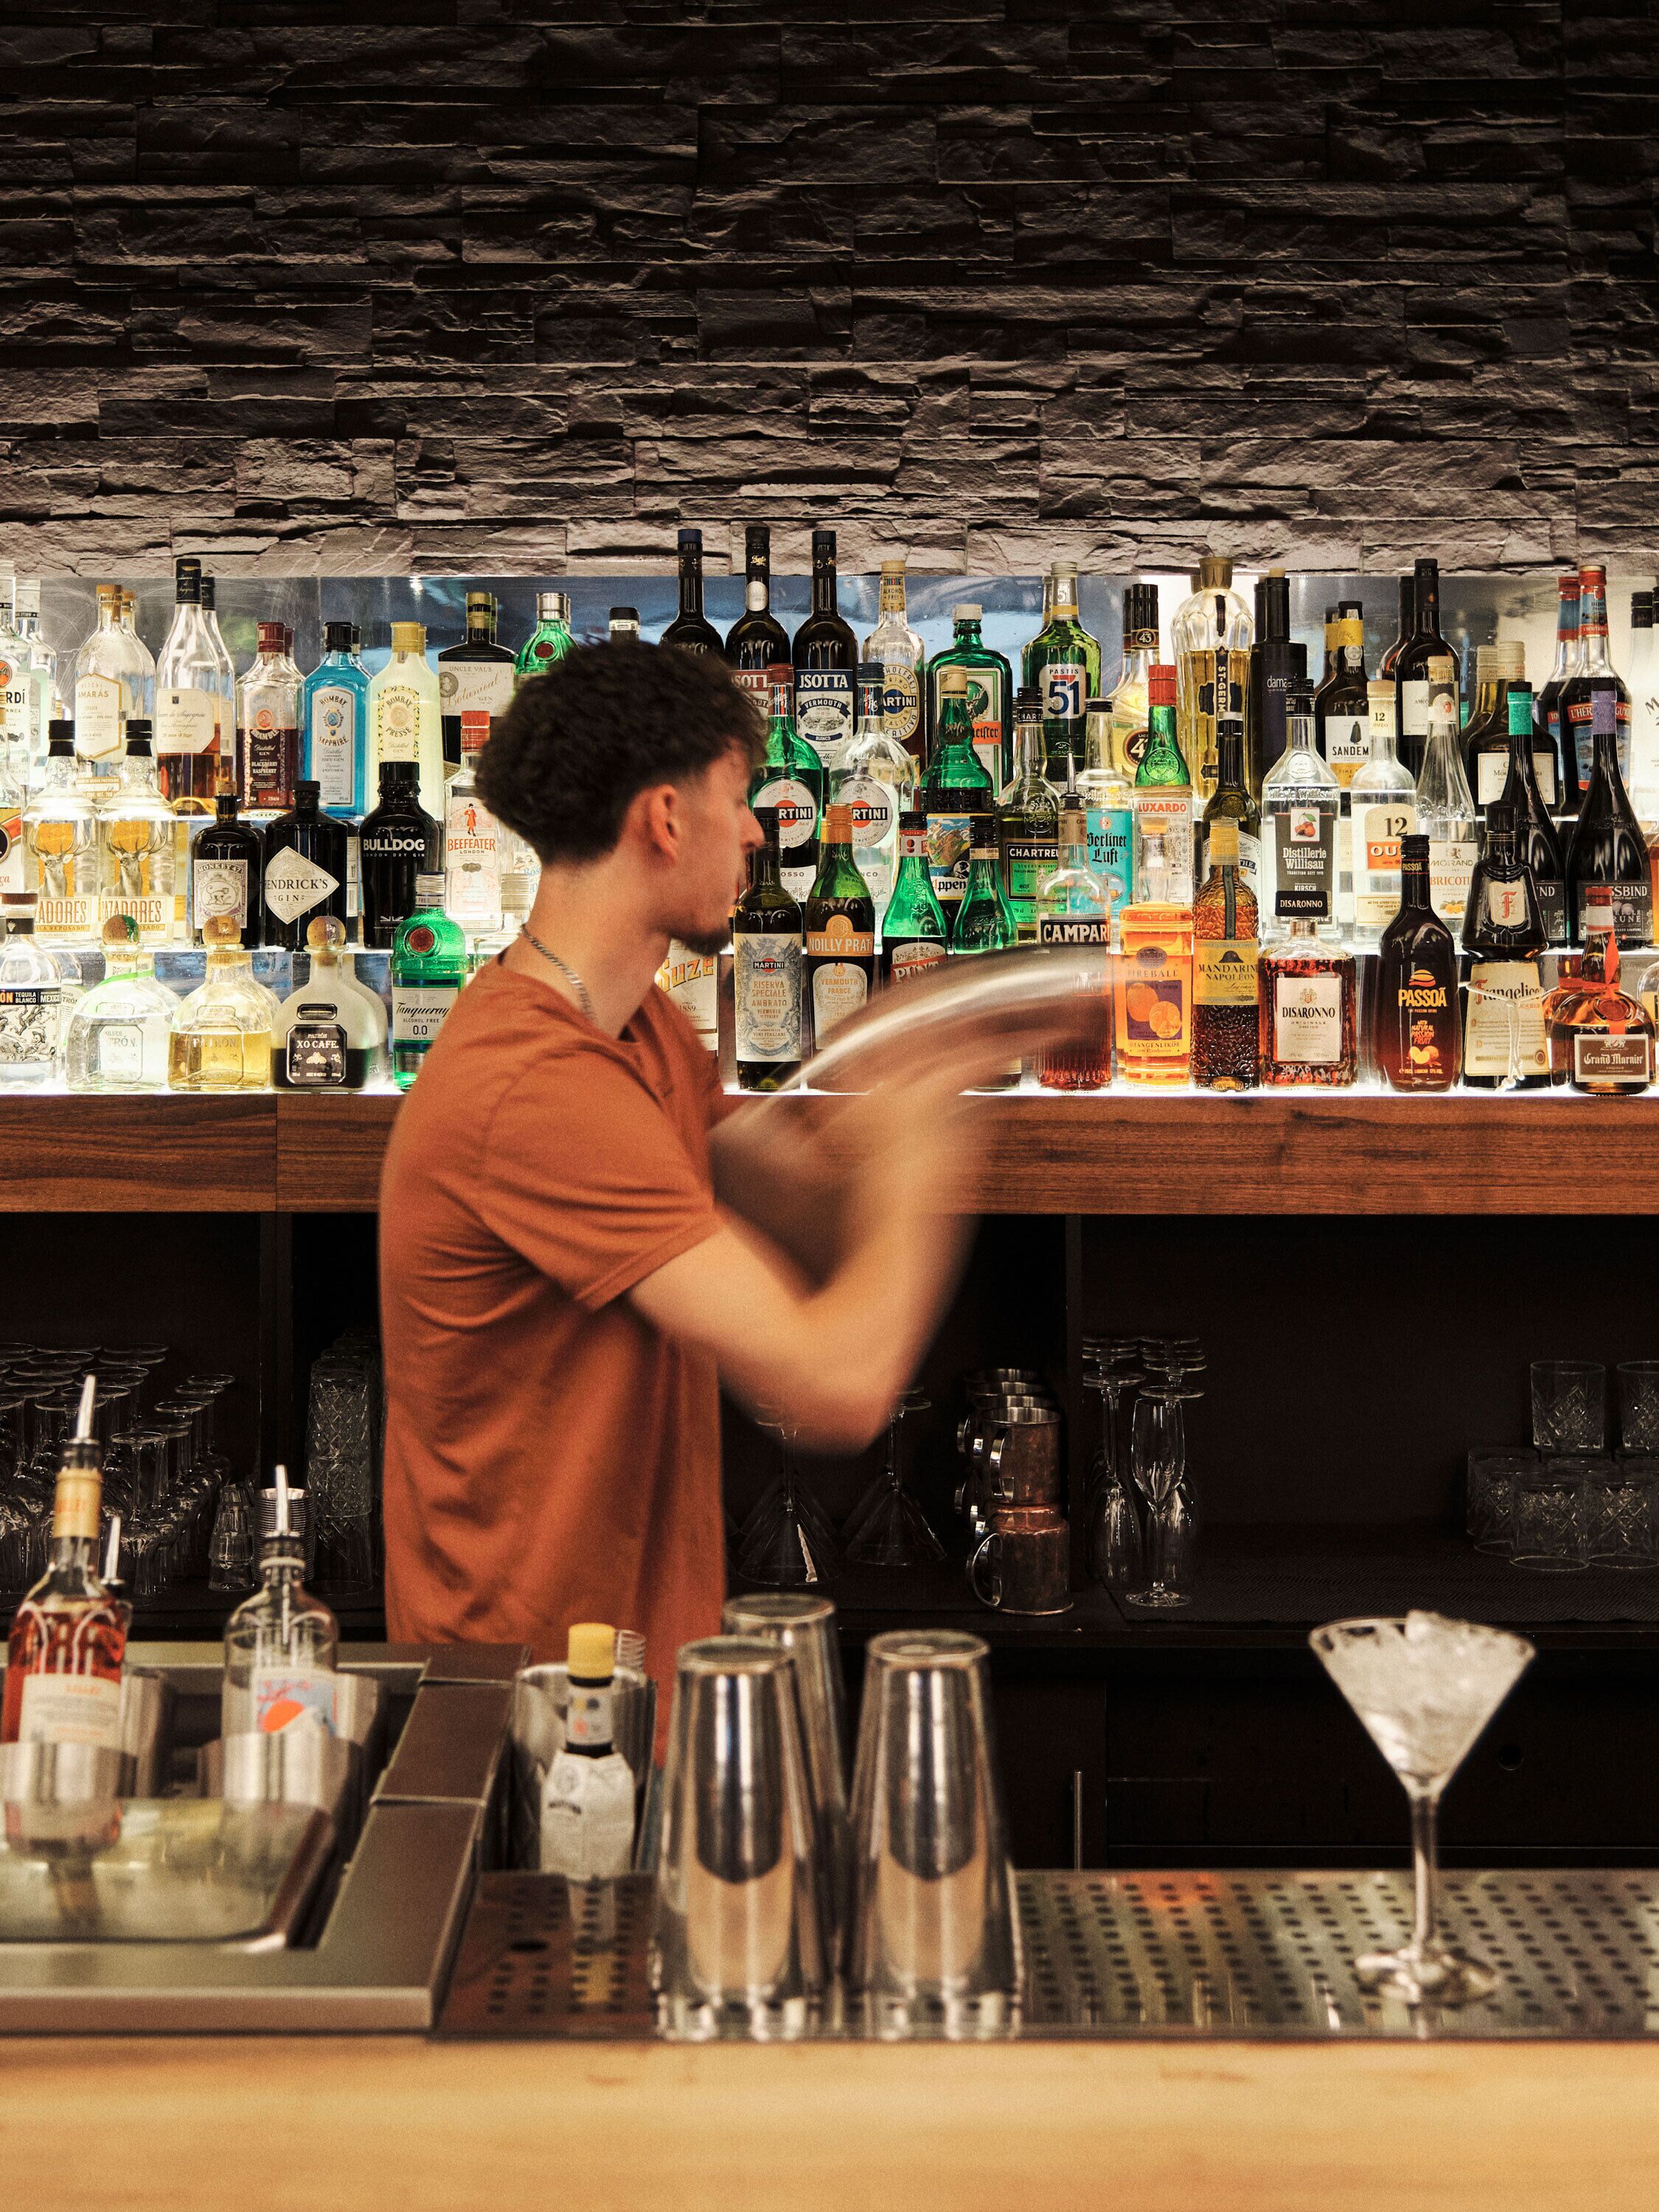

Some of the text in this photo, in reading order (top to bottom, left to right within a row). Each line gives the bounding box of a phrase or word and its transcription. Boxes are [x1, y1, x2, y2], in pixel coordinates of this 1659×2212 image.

[1138, 633, 1152, 643] 43
[734, 675, 768, 689] SOTT
[886, 667, 917, 689] HOLFREI
[1267, 675, 1287, 687] dama
[448, 672, 499, 706] Botanical
[1218, 666, 1227, 712] ST-GERM
[320, 696, 348, 707] BOMBAY
[386, 695, 413, 708] BOMBAY
[883, 696, 916, 706] ARTINI
[1048, 681, 1079, 714] 51
[804, 700, 842, 709] VERMOUTH
[1374, 712, 1385, 721] 12
[1571, 707, 1593, 719] L'HÉR
[885, 716, 908, 726] TALIA
[886, 714, 917, 736] ERITIVO
[251, 728, 279, 740] BRAMBLE
[319, 736, 349, 746] SAPPHIRE
[1130, 739, 1146, 754] 4
[1332, 746, 1368, 756] SANDEM
[779, 808, 811, 818] RTINI
[852, 808, 886, 819] RTINI
[1138, 802, 1186, 813] LUXARDO
[1385, 817, 1408, 837] 12
[363, 839, 425, 851] BULLDOG
[448, 838, 495, 852] BEEFEATER
[1087, 832, 1127, 848] Berliner
[1009, 848, 1058, 857] CHARTRE
[1283, 848, 1327, 858] Distillerie
[1370, 845, 1401, 857] OU
[1092, 849, 1118, 866] Luft
[1285, 858, 1324, 869] Willisau
[198, 863, 233, 873] MONKEY
[265, 879, 327, 889] ENDRICK'S
[1430, 876, 1470, 886] BRICOTI
[1607, 886, 1647, 897] SSBIND
[1280, 900, 1323, 908] DISARONNO
[36, 900, 87, 923] ADORES
[102, 900, 162, 923] AZADORES
[1043, 923, 1110, 944] CAMPARI
[809, 937, 872, 952] NOILLY PRAT
[656, 956, 714, 992] Suze
[754, 981, 785, 989] RISERVA
[1398, 987, 1447, 1007] PASSOÃ
[1475, 979, 1540, 1006] Frangelico
[397, 1002, 450, 1018] Tanqueray
[1282, 1007, 1335, 1019] DISARONNO
[413, 1025, 428, 1036] 0.0
[109, 1035, 138, 1047] TRÓN
[296, 1040, 310, 1048] XO
[1584, 1053, 1644, 1065] Grand Marnier
